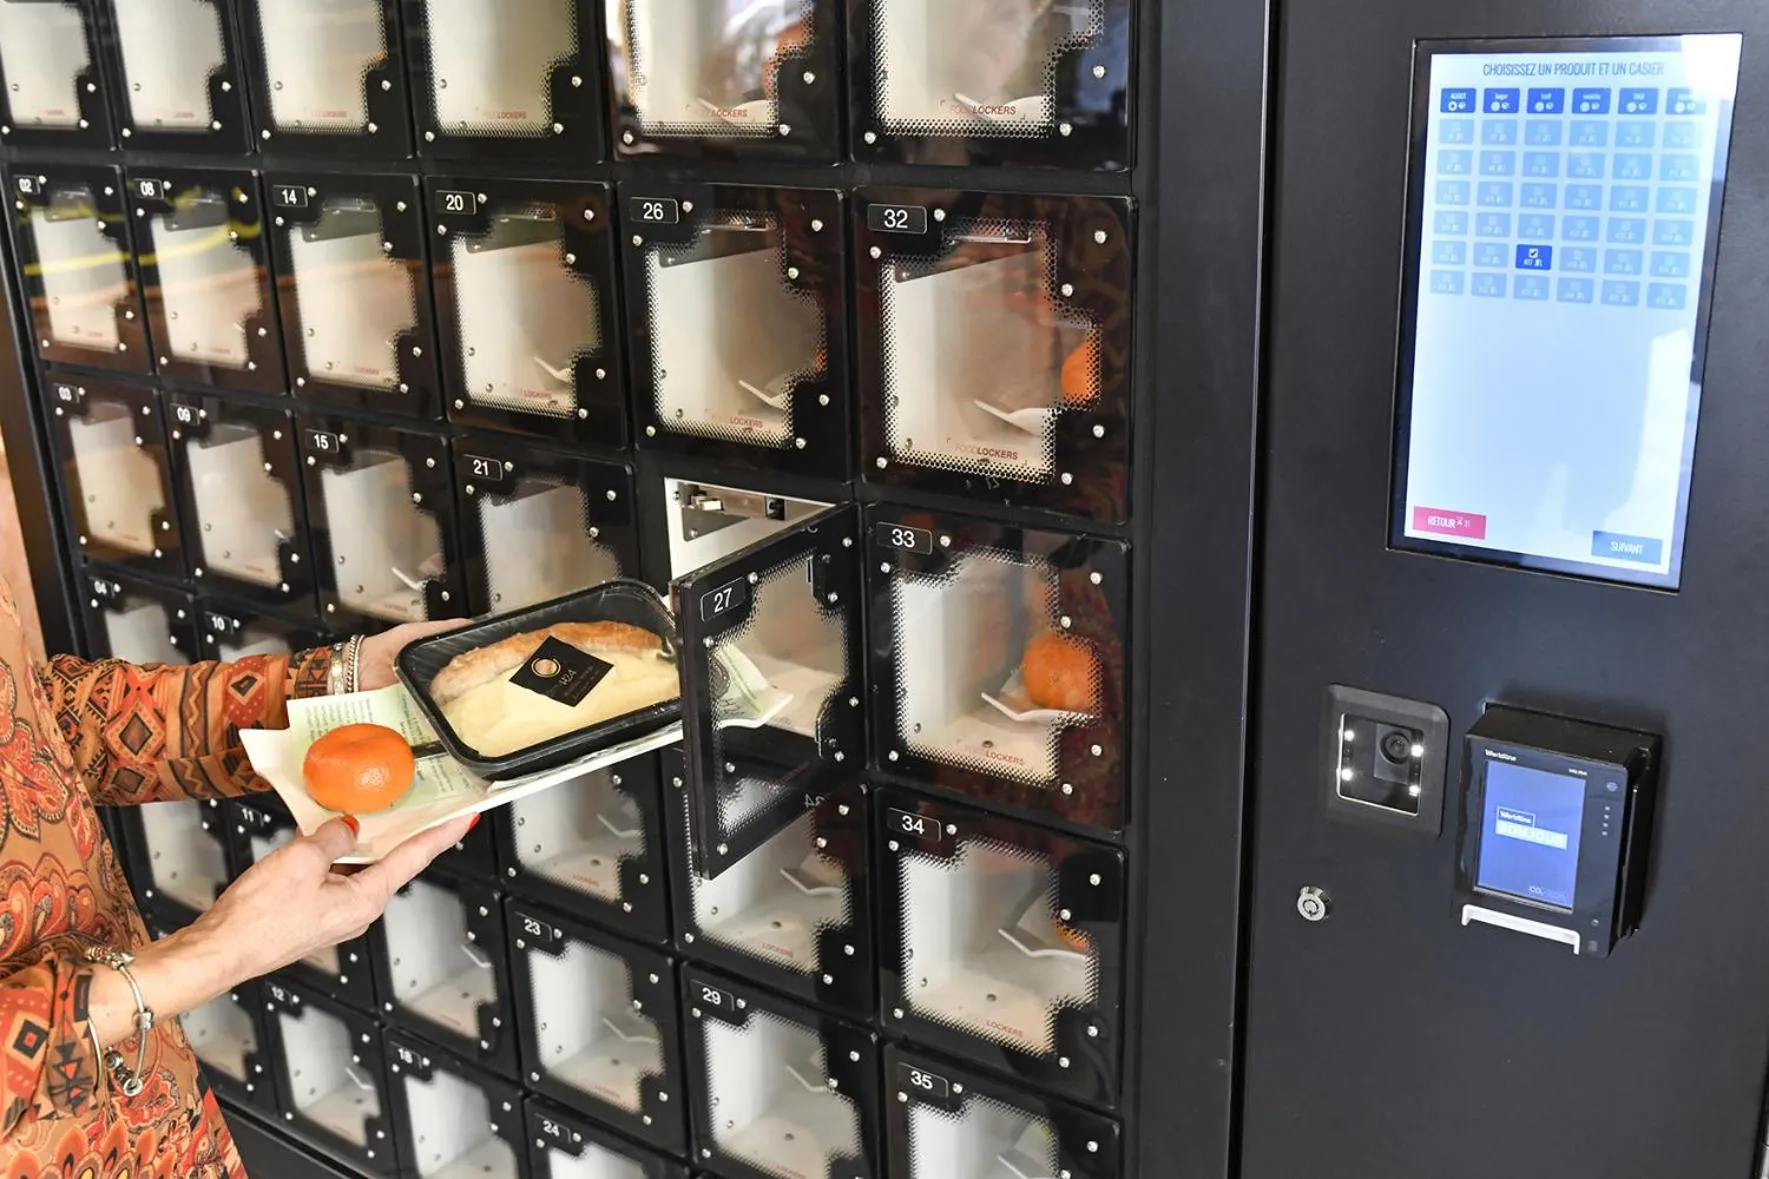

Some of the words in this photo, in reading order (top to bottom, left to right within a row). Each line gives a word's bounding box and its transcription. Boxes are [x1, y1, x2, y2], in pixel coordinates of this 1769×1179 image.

[1483, 63, 1536, 76] CHOISISSEZ
[1538, 63, 1552, 75] UN
[1554, 63, 1597, 76] PRODUIT
[1598, 63, 1610, 75] ET
[1612, 63, 1626, 75] UN
[282, 189, 297, 205] 14
[446, 194, 464, 212] 20
[642, 202, 664, 220] 26
[883, 209, 908, 229] 32
[313, 433, 329, 450] 15
[473, 459, 489, 477] 21
[1427, 514, 1457, 529] RETOUR
[891, 528, 915, 548] 33
[1610, 541, 1645, 555] SUIVANT
[714, 587, 733, 614] 27
[211, 615, 225, 632] 10
[985, 750, 1025, 766] LOCKERS
[242, 807, 254, 823] 11
[901, 815, 925, 835] 34
[524, 918, 541, 936] 23
[272, 986, 285, 1001] 12
[702, 987, 722, 1006] 29
[398, 1048, 413, 1065] 18
[910, 1070, 934, 1091] 35
[543, 1120, 560, 1138] 24
